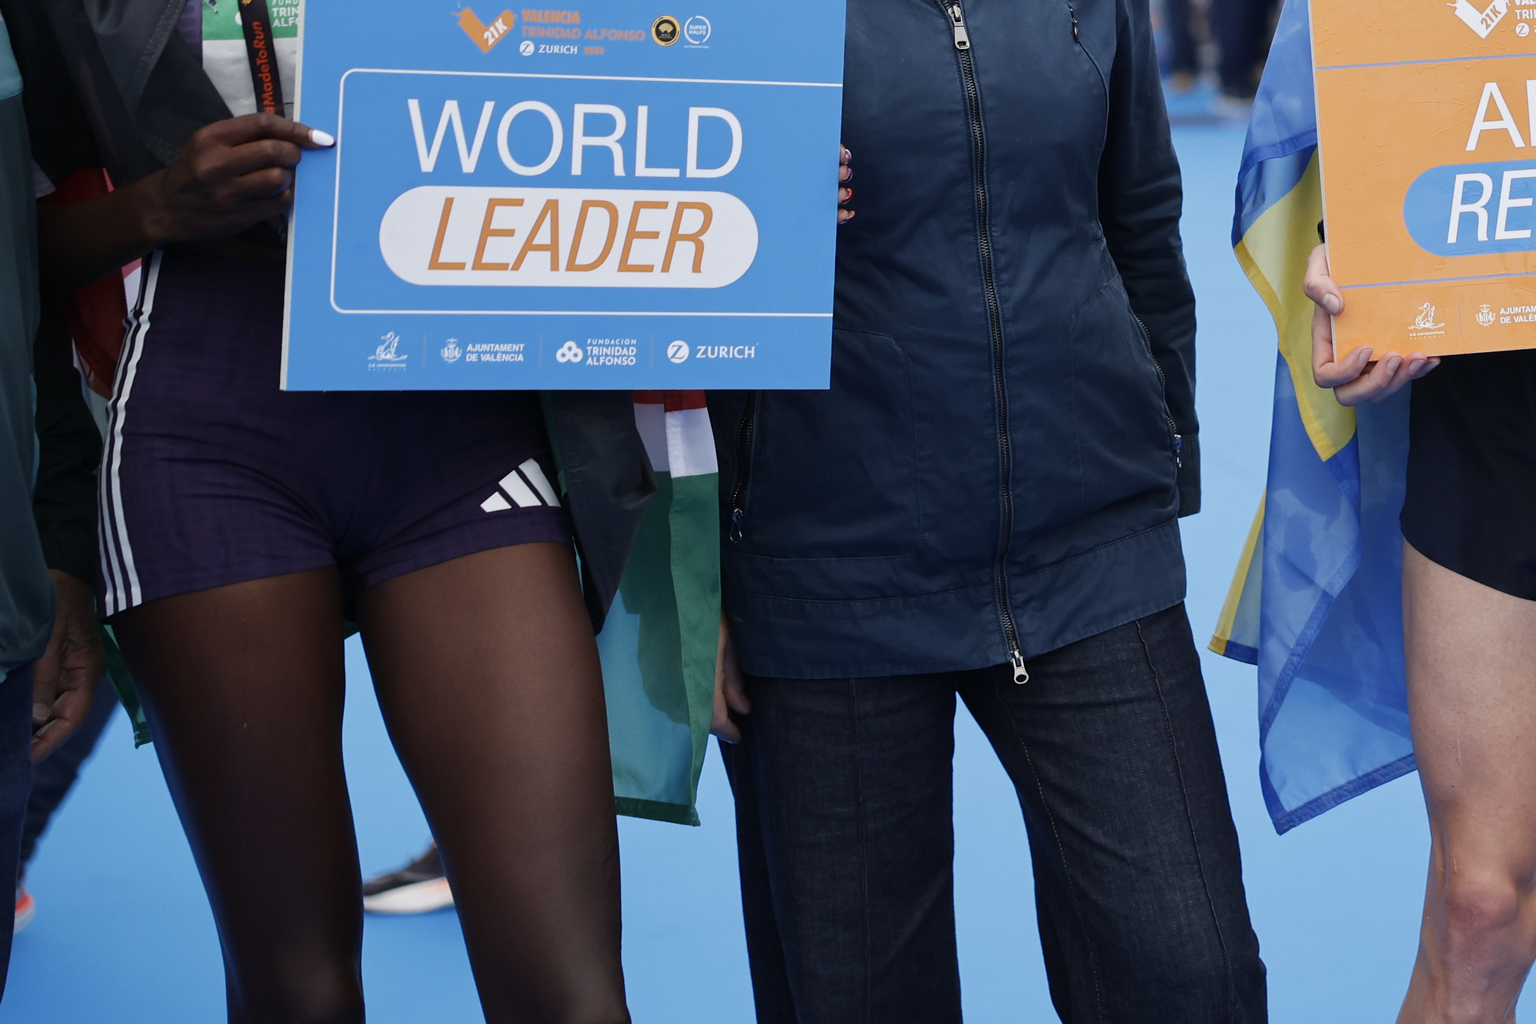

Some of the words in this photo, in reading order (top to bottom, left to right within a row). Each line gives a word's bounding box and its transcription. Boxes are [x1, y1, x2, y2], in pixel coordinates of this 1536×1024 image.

[521, 9, 581, 24] VALENCIA
[1480, 6, 1502, 31] 21K
[483, 18, 509, 46] 21K
[522, 26, 582, 40] TRINIDAD
[584, 28, 646, 42] ALFONSO
[538, 44, 578, 55] ZURICH
[252, 21, 276, 114] #MadeToRun
[408, 98, 743, 179] WORLD
[427, 196, 714, 274] LEADER
[1500, 315, 1512, 324] DE
[467, 344, 525, 352] AJUNTAMENT
[587, 338, 637, 346] FUNDACIÓN
[466, 354, 479, 362] DE
[586, 346, 637, 356] TRINIDAD
[696, 345, 755, 359] ZURICH
[586, 356, 636, 366] ALFONSO
